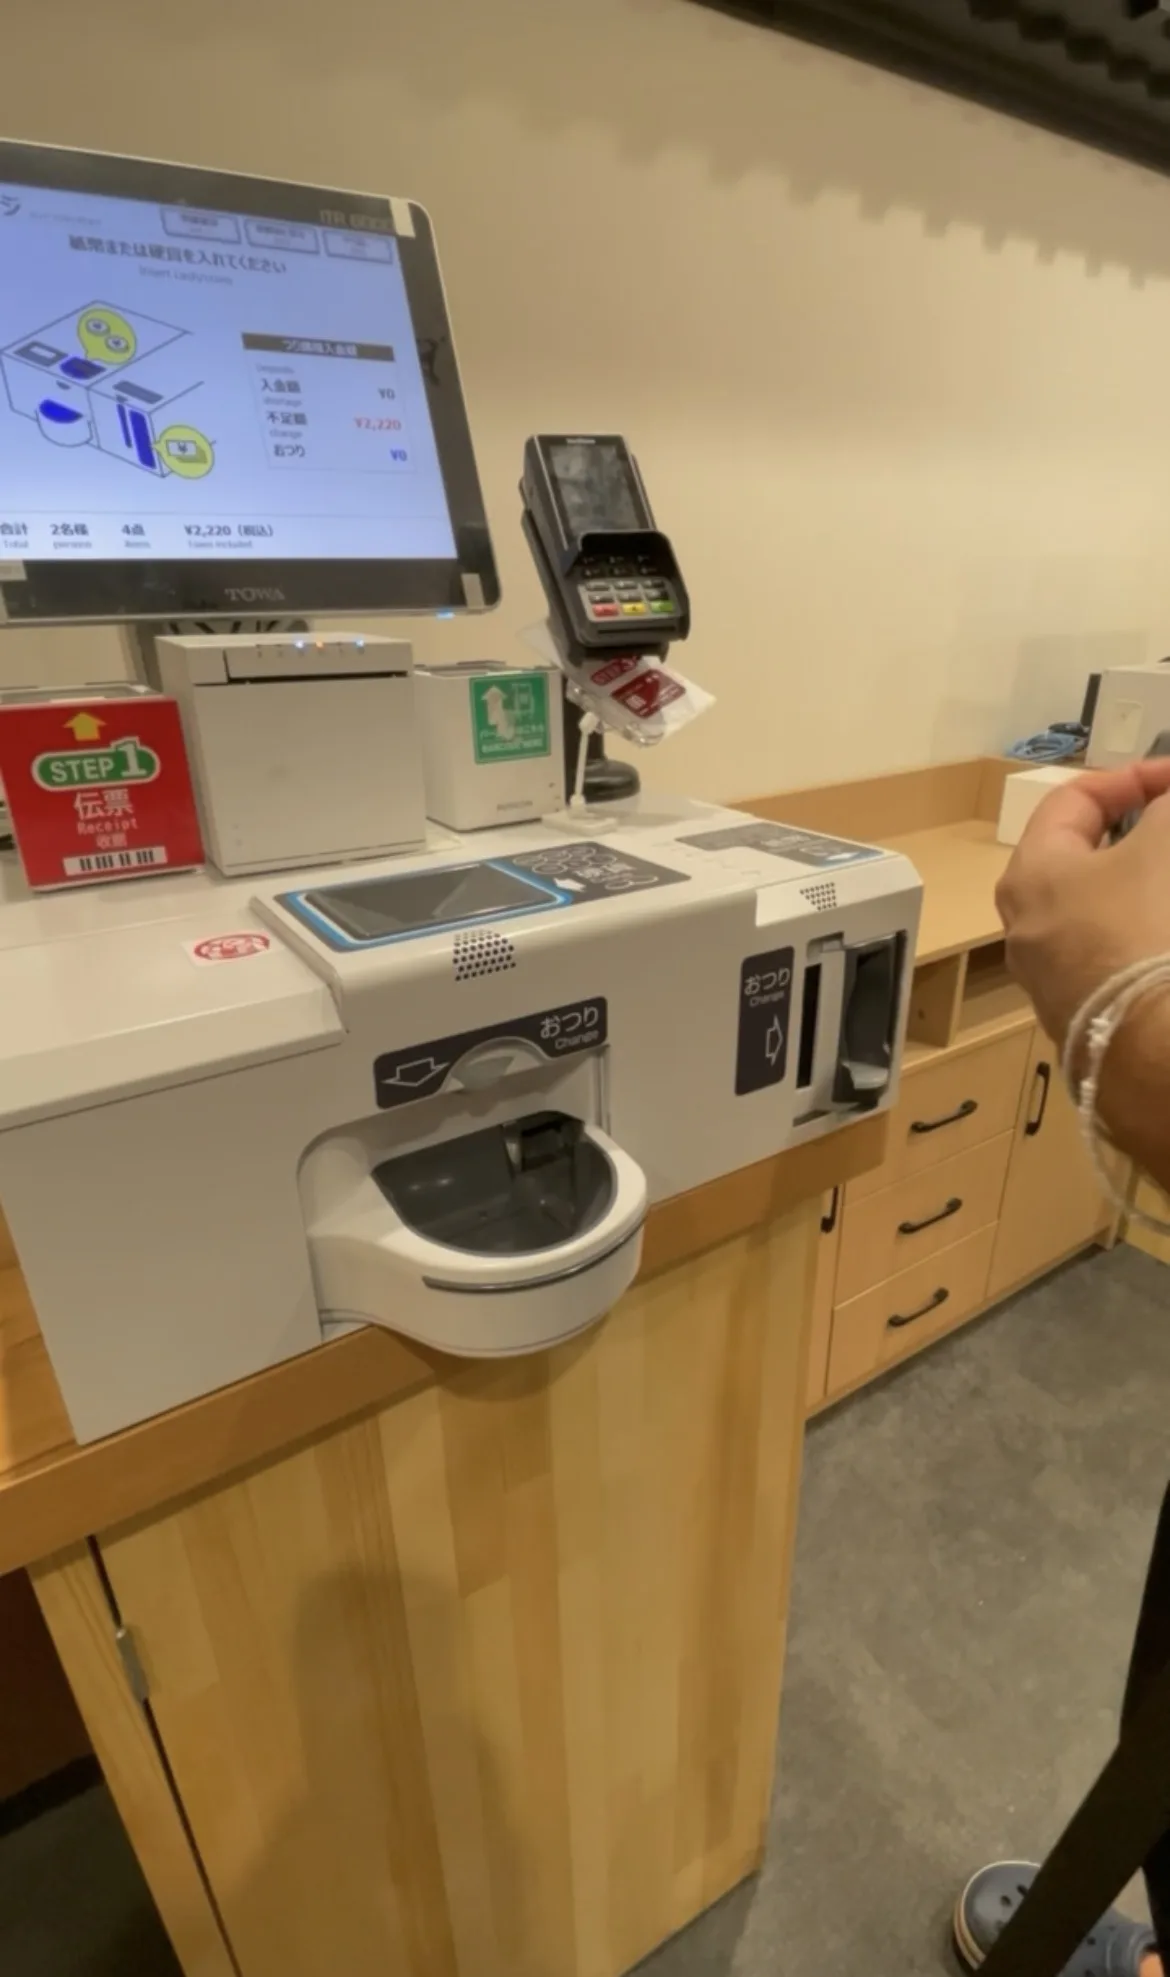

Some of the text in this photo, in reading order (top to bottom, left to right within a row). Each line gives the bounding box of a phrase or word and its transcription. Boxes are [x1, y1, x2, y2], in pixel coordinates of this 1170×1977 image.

[265, 411, 308, 426] 不足額
[354, 416, 403, 432] ¥2,220
[273, 443, 306, 459] おつり
[184, 523, 232, 538] ¥2,220
[224, 587, 286, 602] TOWA
[50, 743, 147, 783] STEP 1
[73, 788, 134, 820] 伝票
[77, 818, 138, 835] Receipt
[744, 967, 791, 996] おつり
[749, 990, 785, 1008] Change
[540, 1007, 599, 1039] おつり
[555, 1030, 599, 1050] Change
